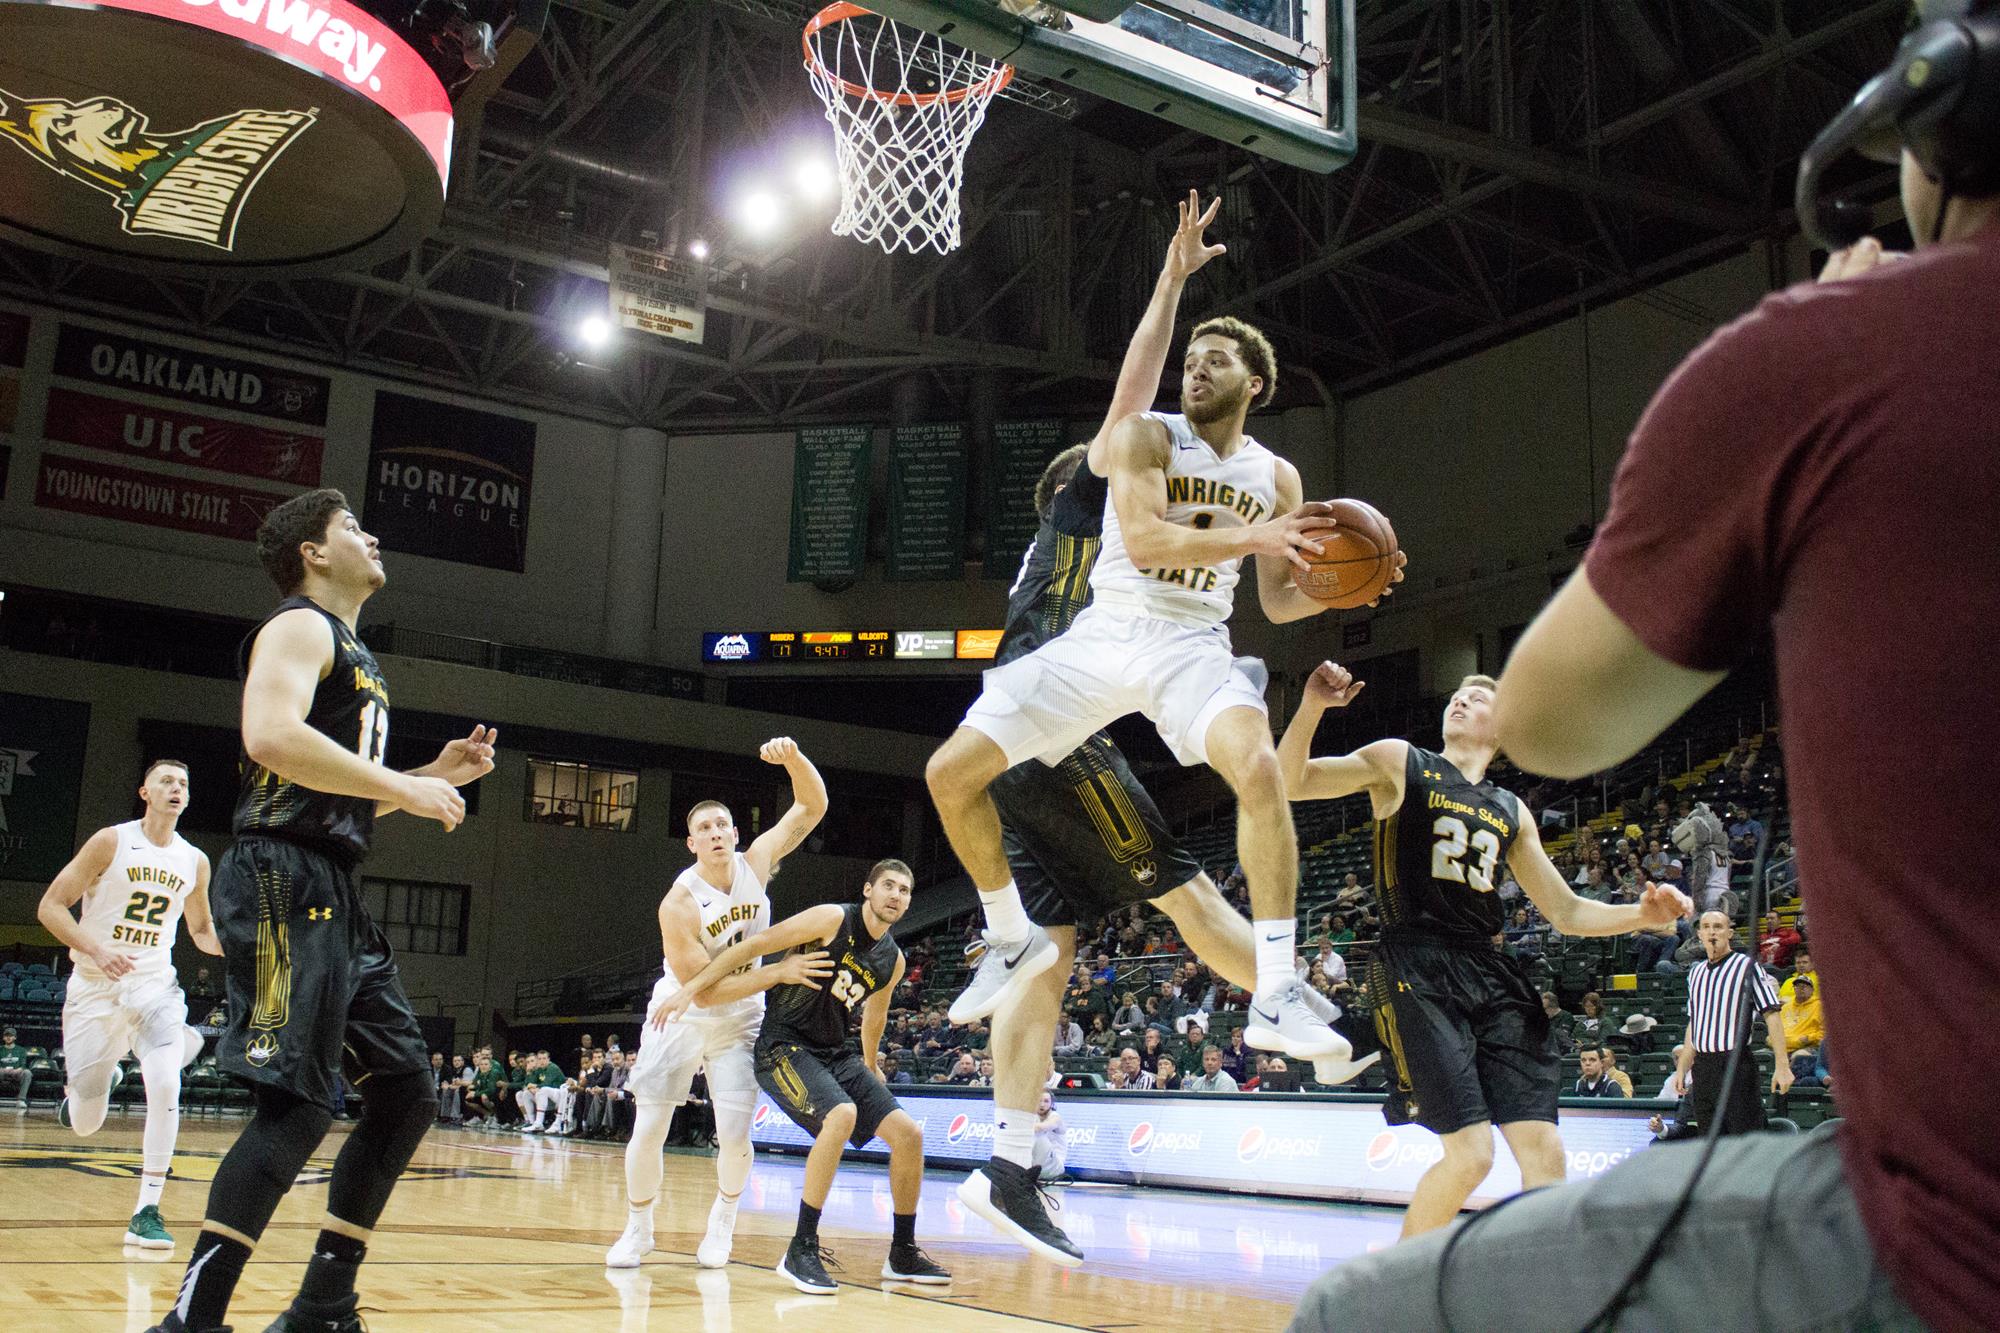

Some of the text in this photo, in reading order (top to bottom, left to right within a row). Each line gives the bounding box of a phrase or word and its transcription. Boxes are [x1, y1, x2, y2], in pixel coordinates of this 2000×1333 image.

[131, 113, 305, 242] WRIGHT STATE
[90, 344, 263, 404] OAKLAND
[123, 414, 204, 458] UIC
[802, 428, 866, 437] BASKETBALL
[897, 425, 962, 435] BASKETBALL
[922, 433, 936, 441] OF
[938, 432, 962, 440] FAME
[994, 421, 1063, 431] BASKETBALL
[828, 436, 841, 444] OF
[44, 467, 231, 524] YOUNGSTOWN STATE
[380, 461, 520, 509] HORIZON
[378, 489, 520, 528] LEAGUE
[1165, 477, 1266, 525] WRIGHT
[1138, 566, 1218, 593] TATE
[770, 633, 795, 642] RAIDERS
[858, 632, 888, 641] WILDCATS
[896, 633, 924, 653] yp
[779, 644, 883, 657] 17 9:47 21
[1428, 790, 1510, 838] Wayne State
[1431, 815, 1501, 894] 23
[127, 867, 186, 893] WRIGHT
[123, 890, 171, 927] 22
[706, 904, 760, 938] WRGHT
[111, 924, 161, 947] STATE
[841, 951, 863, 976] Wayne
[965, 1122, 996, 1142] pep
[1150, 1130, 1204, 1154] pepsi
[1264, 1136, 1323, 1160] pepsi
[1397, 1143, 1445, 1168] pep
